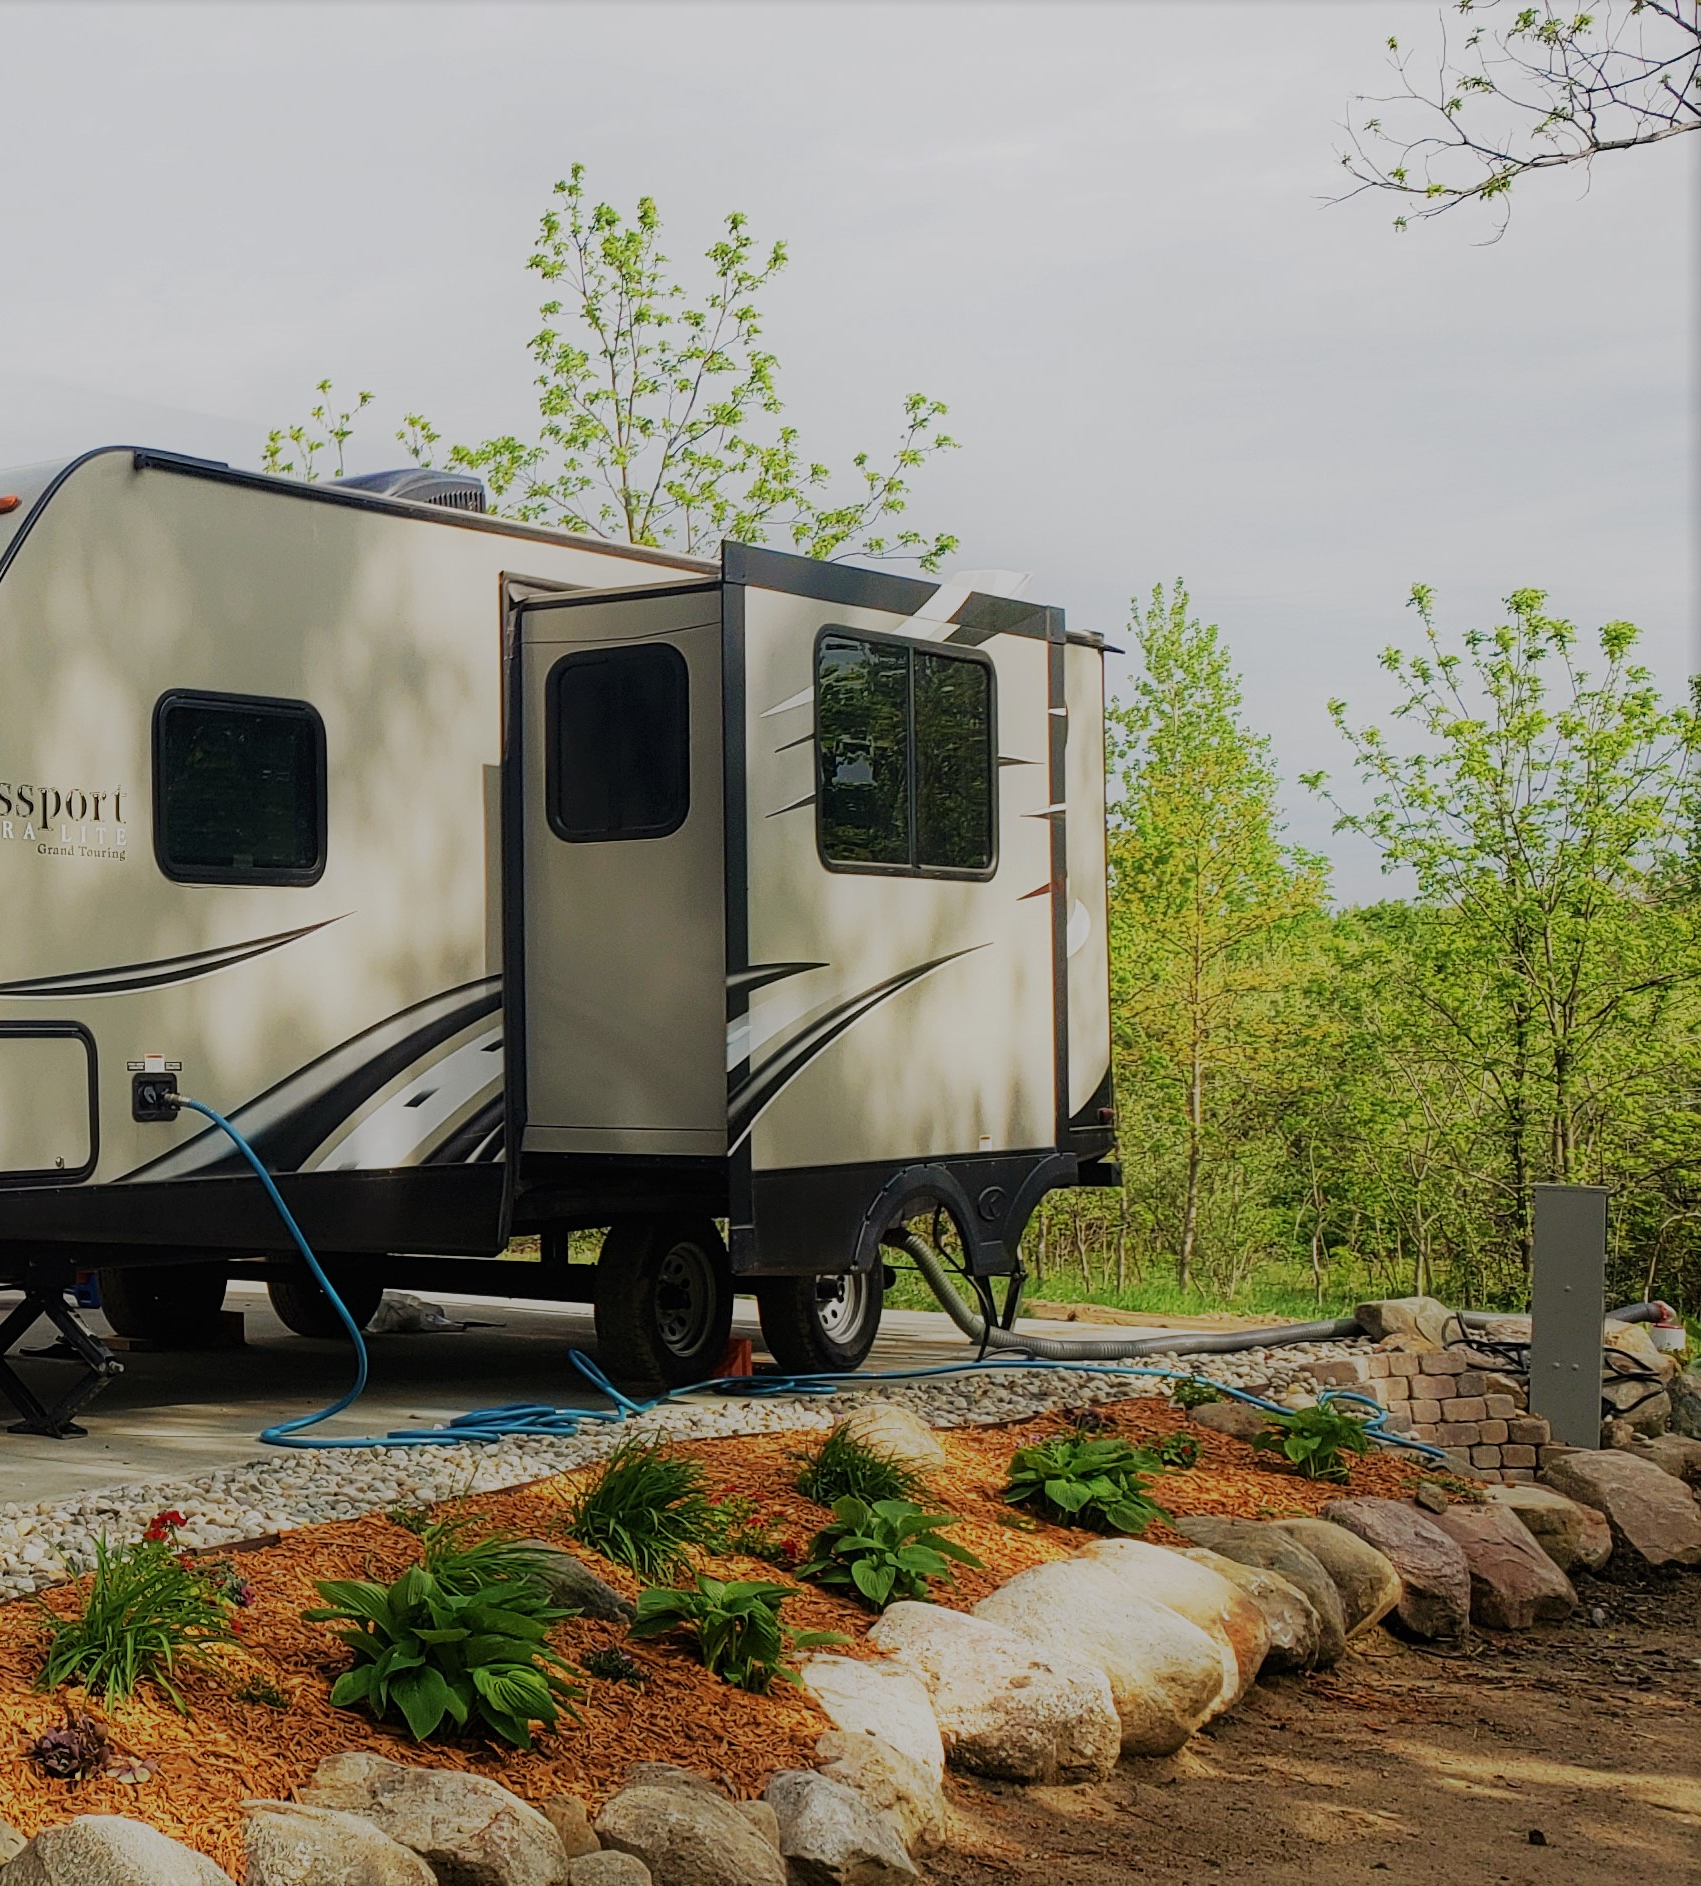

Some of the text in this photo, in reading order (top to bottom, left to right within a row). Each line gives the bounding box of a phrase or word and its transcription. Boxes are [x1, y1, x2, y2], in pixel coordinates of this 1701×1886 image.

[61, 824, 127, 846] LITE
[37, 843, 126, 861] Grand Touring
